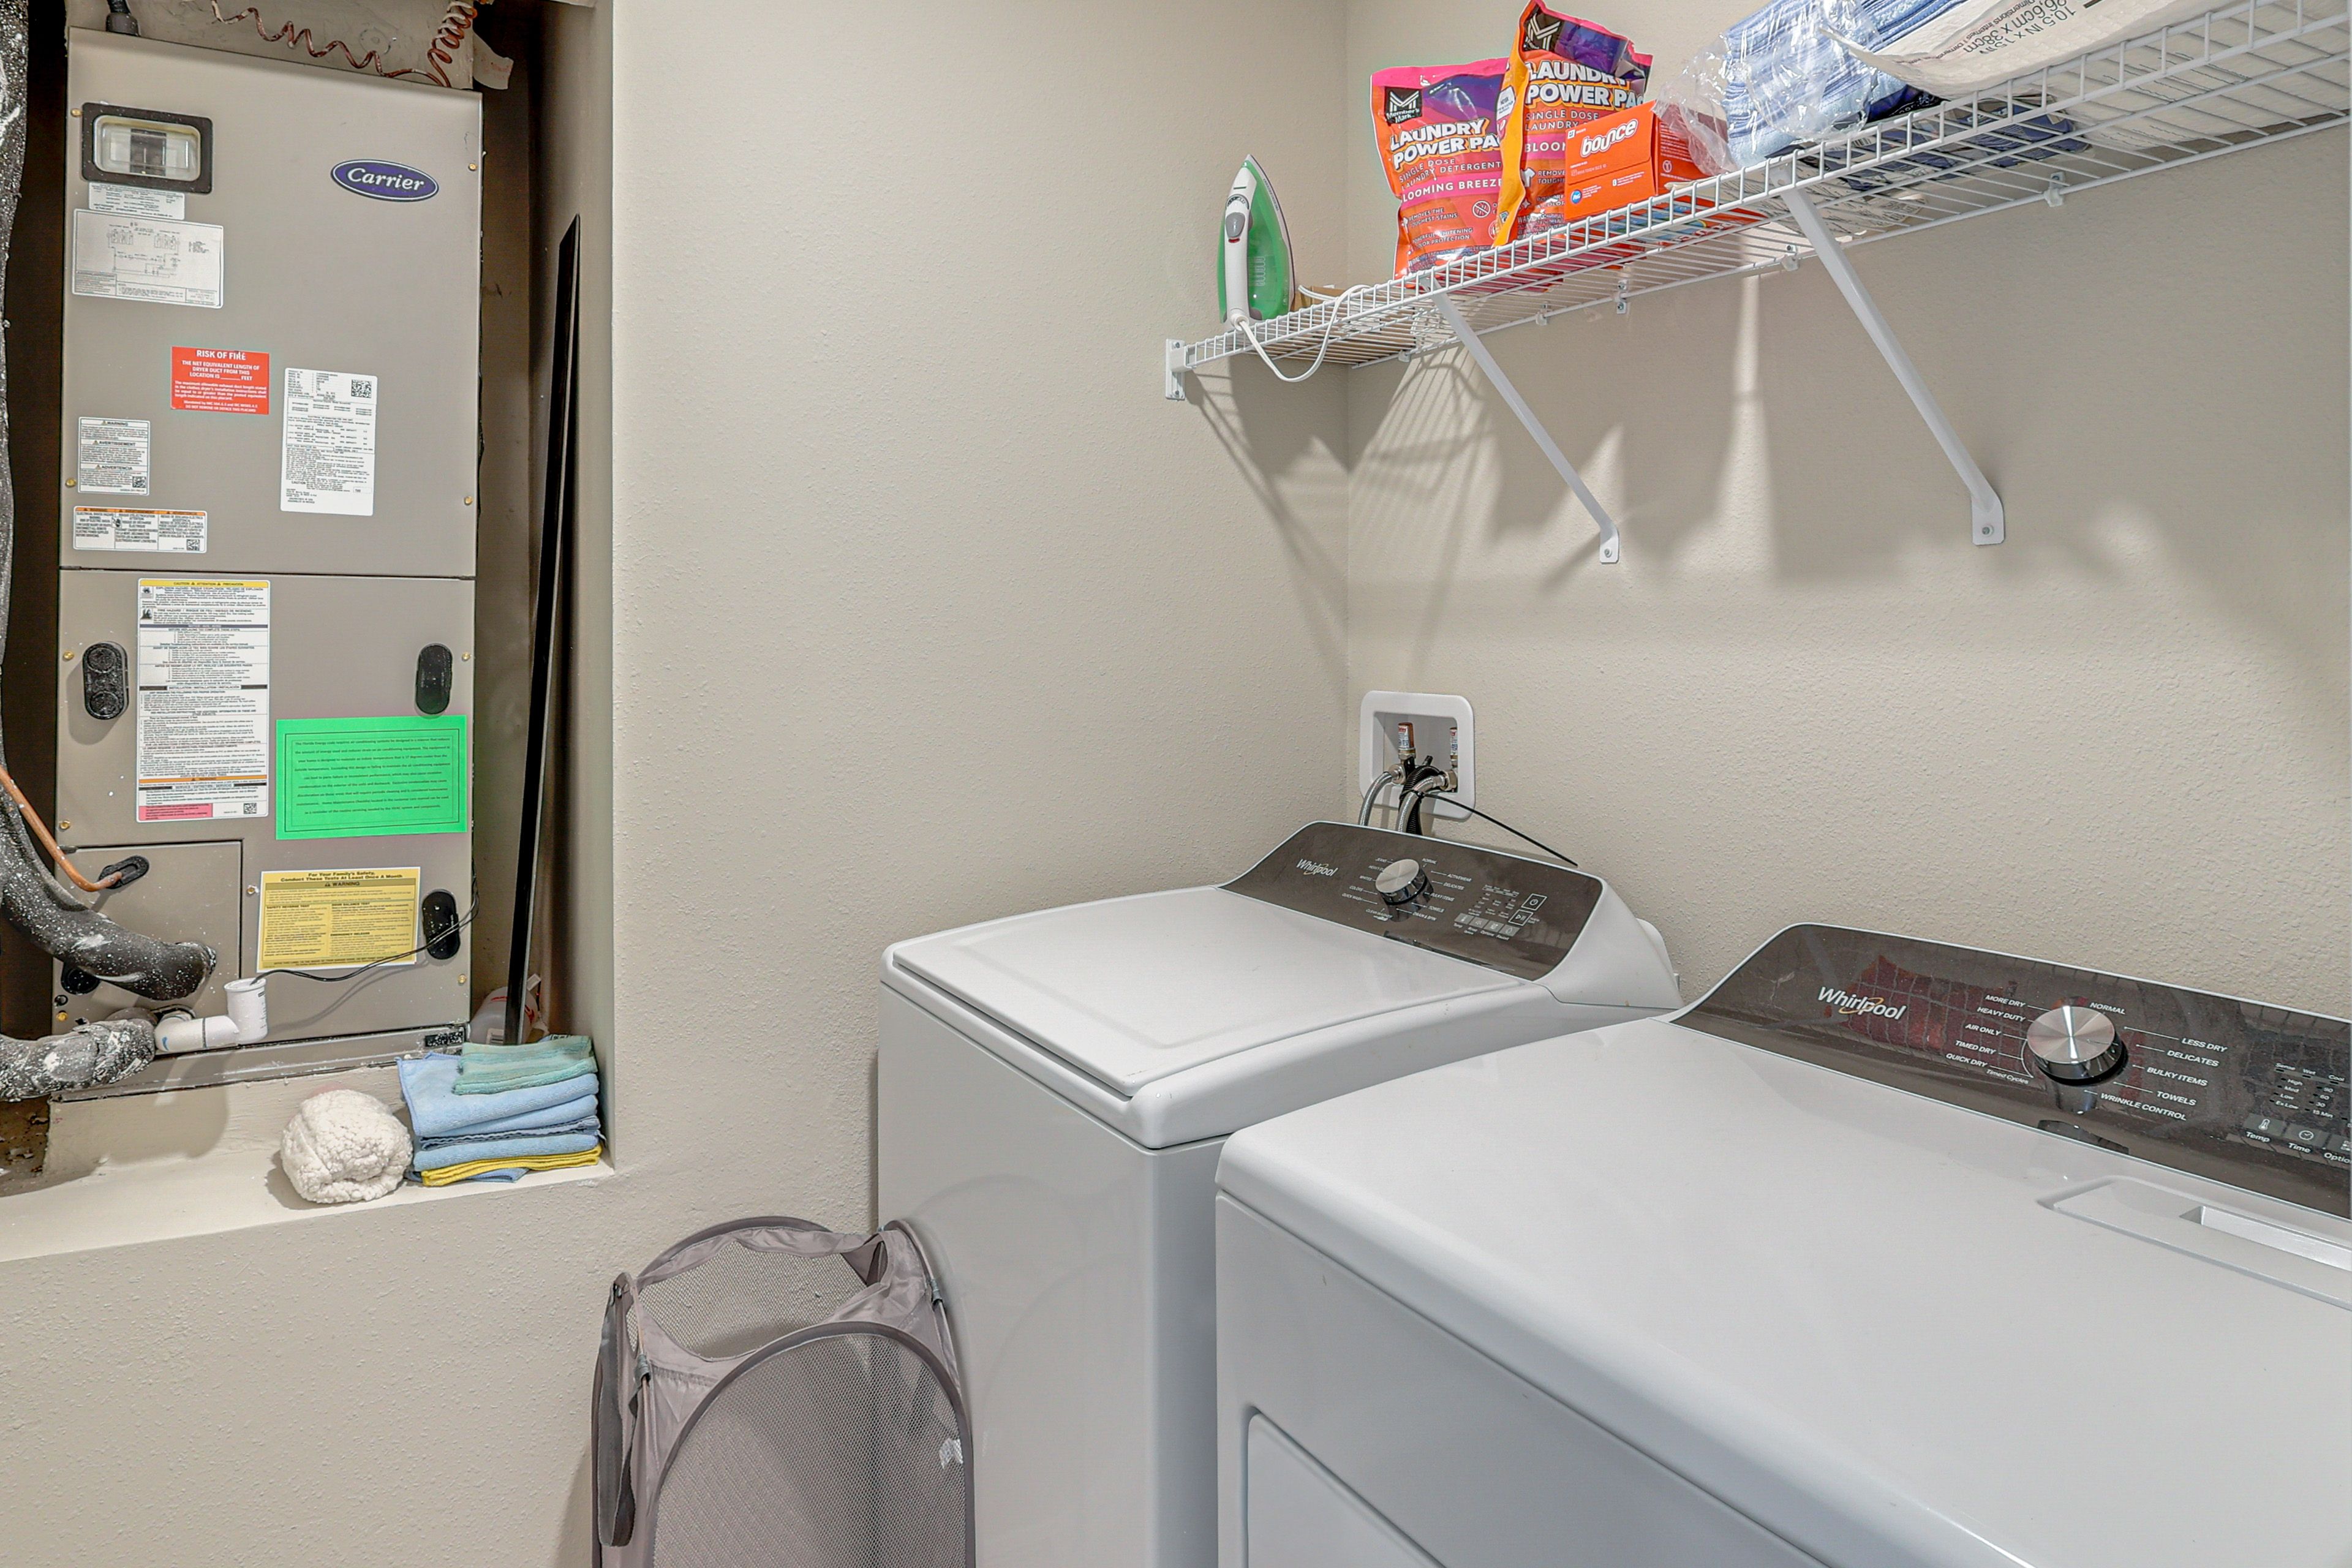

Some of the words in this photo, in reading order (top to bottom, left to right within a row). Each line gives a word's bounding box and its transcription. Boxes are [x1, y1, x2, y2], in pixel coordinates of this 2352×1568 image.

[1963, 29, 2003, 53] 38cm
[1525, 84, 1610, 107] POWER
[1386, 108, 1420, 120] Member's
[1395, 114, 1412, 124] Mark
[1526, 110, 1566, 121] SINGLE
[1570, 110, 1599, 120] DOSE
[1525, 121, 1578, 131] LAUNDRY
[1390, 119, 1485, 151] LAUNDRY
[1581, 119, 1637, 156] bounce
[1393, 137, 1466, 170] POWER
[1471, 134, 1499, 149] PA
[1399, 164, 1424, 183] SINGLE
[1428, 159, 1455, 167] DOSE
[1440, 161, 1501, 173] DETERGENT
[348, 168, 424, 190] Carrier
[1403, 182, 1454, 202] LOOMING
[1411, 217, 1435, 227] OUGHEST
[1441, 227, 1473, 236] HITENING
[1295, 858, 1339, 878] Whirlpool
[1817, 986, 1907, 1021] Whirlpool
[1985, 995, 2008, 1005] MORE
[1977, 1006, 2004, 1017] HEAVY
[2003, 1012, 2026, 1022] DUTY
[2090, 1002, 2126, 1015] NORMAL
[1980, 1027, 2002, 1036] ONLY
[1955, 1040, 1979, 1050] TIMED
[1979, 1046, 1997, 1055] DRY
[2182, 1038, 2207, 1049] LESS
[2207, 1043, 2228, 1052] DRY
[1946, 1053, 1971, 1064] QUICK
[1970, 1059, 1988, 1068] DRY
[2167, 1050, 2220, 1067] DELICATES
[1986, 1069, 2007, 1078] Timed
[2007, 1074, 2029, 1084] Cycles
[2147, 1067, 2179, 1079] BULKY
[2178, 1074, 2209, 1087] ITEMS
[2157, 1091, 2197, 1106] TOWELS
[2101, 1093, 2141, 1109] WRINKLE
[2141, 1104, 2187, 1121] CONTROL
[2246, 1131, 2271, 1142] Temp
[2288, 1142, 2311, 1153] Time
[2324, 1152, 2351, 1164] Optio
